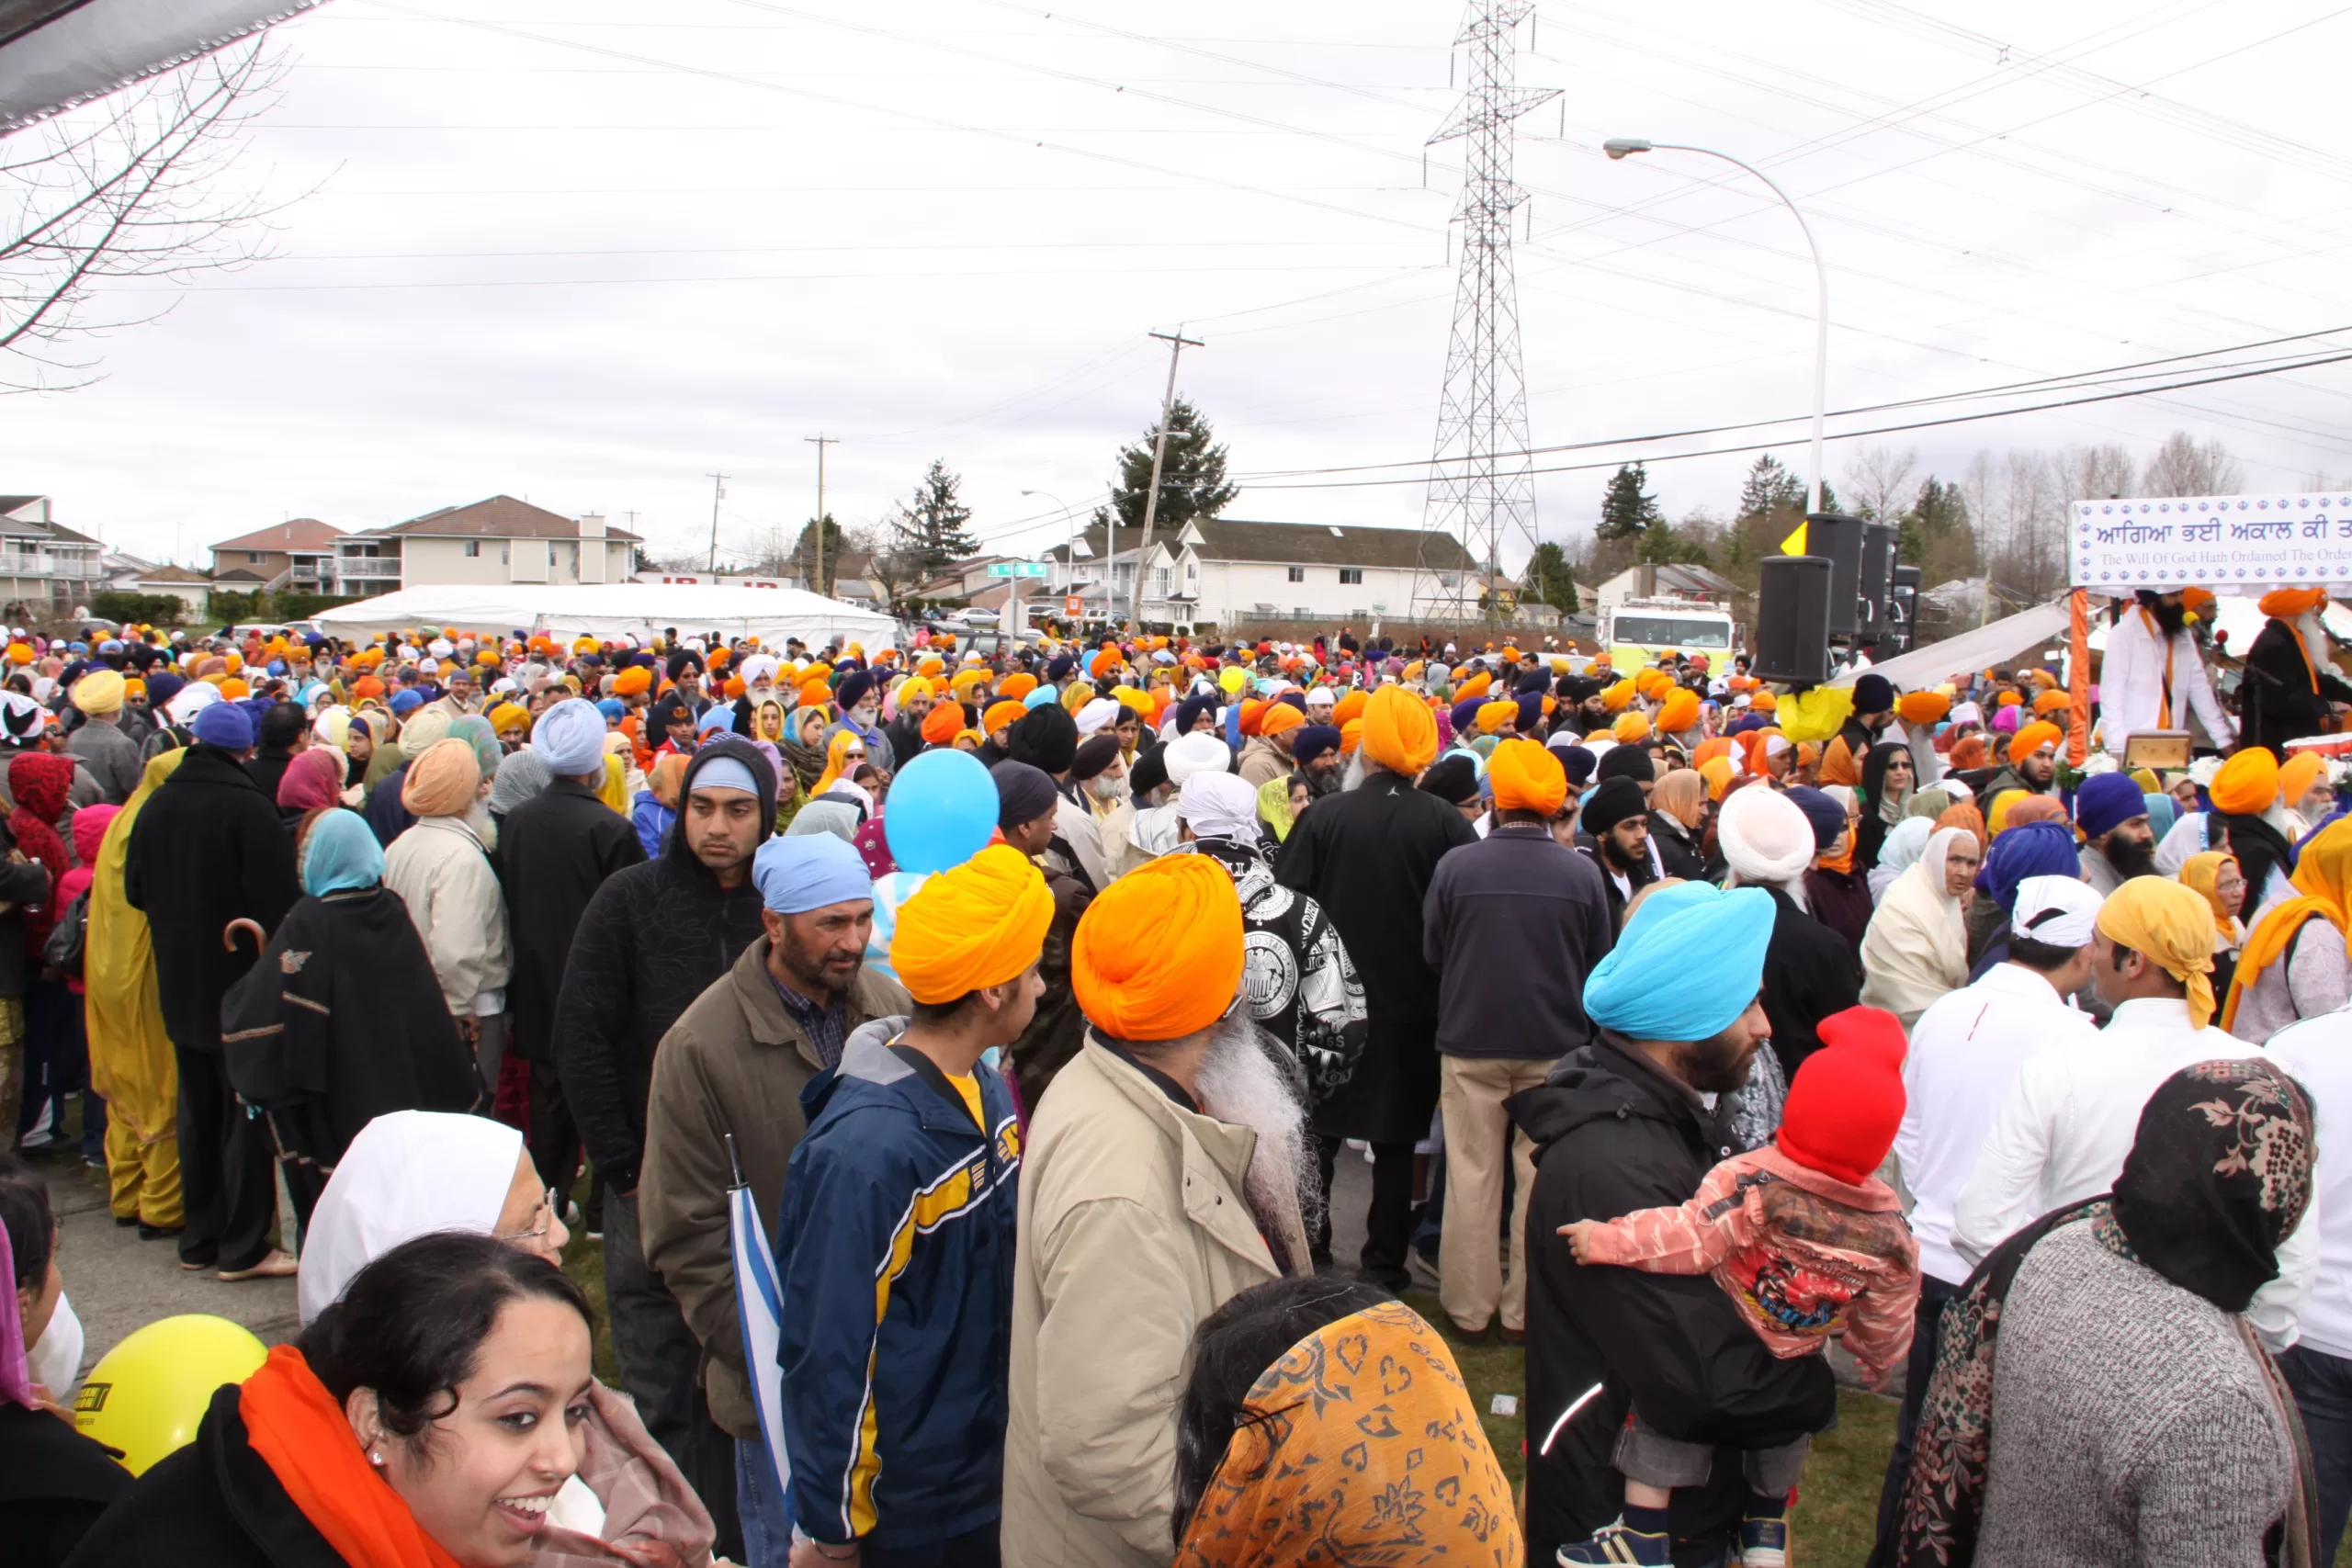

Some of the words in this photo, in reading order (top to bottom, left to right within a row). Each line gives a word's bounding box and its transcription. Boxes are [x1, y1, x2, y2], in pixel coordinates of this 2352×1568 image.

[2096, 520, 2174, 545] ਆਗਿਆ
[2181, 517, 2222, 542] ਭਈ
[2230, 522, 2294, 541] ਅਕਾਲ
[2301, 513, 2329, 539] ਕੀ
[2101, 553, 2123, 565] The
[2126, 553, 2149, 565] Will
[2153, 552, 2168, 564] Of
[2171, 551, 2196, 564] God
[2200, 551, 2228, 563] Hath
[2231, 549, 2287, 562] Ordained
[2290, 548, 2313, 561] The
[1264, 937, 1291, 962] STATES
[1276, 969, 1295, 1004] SYSTEM
